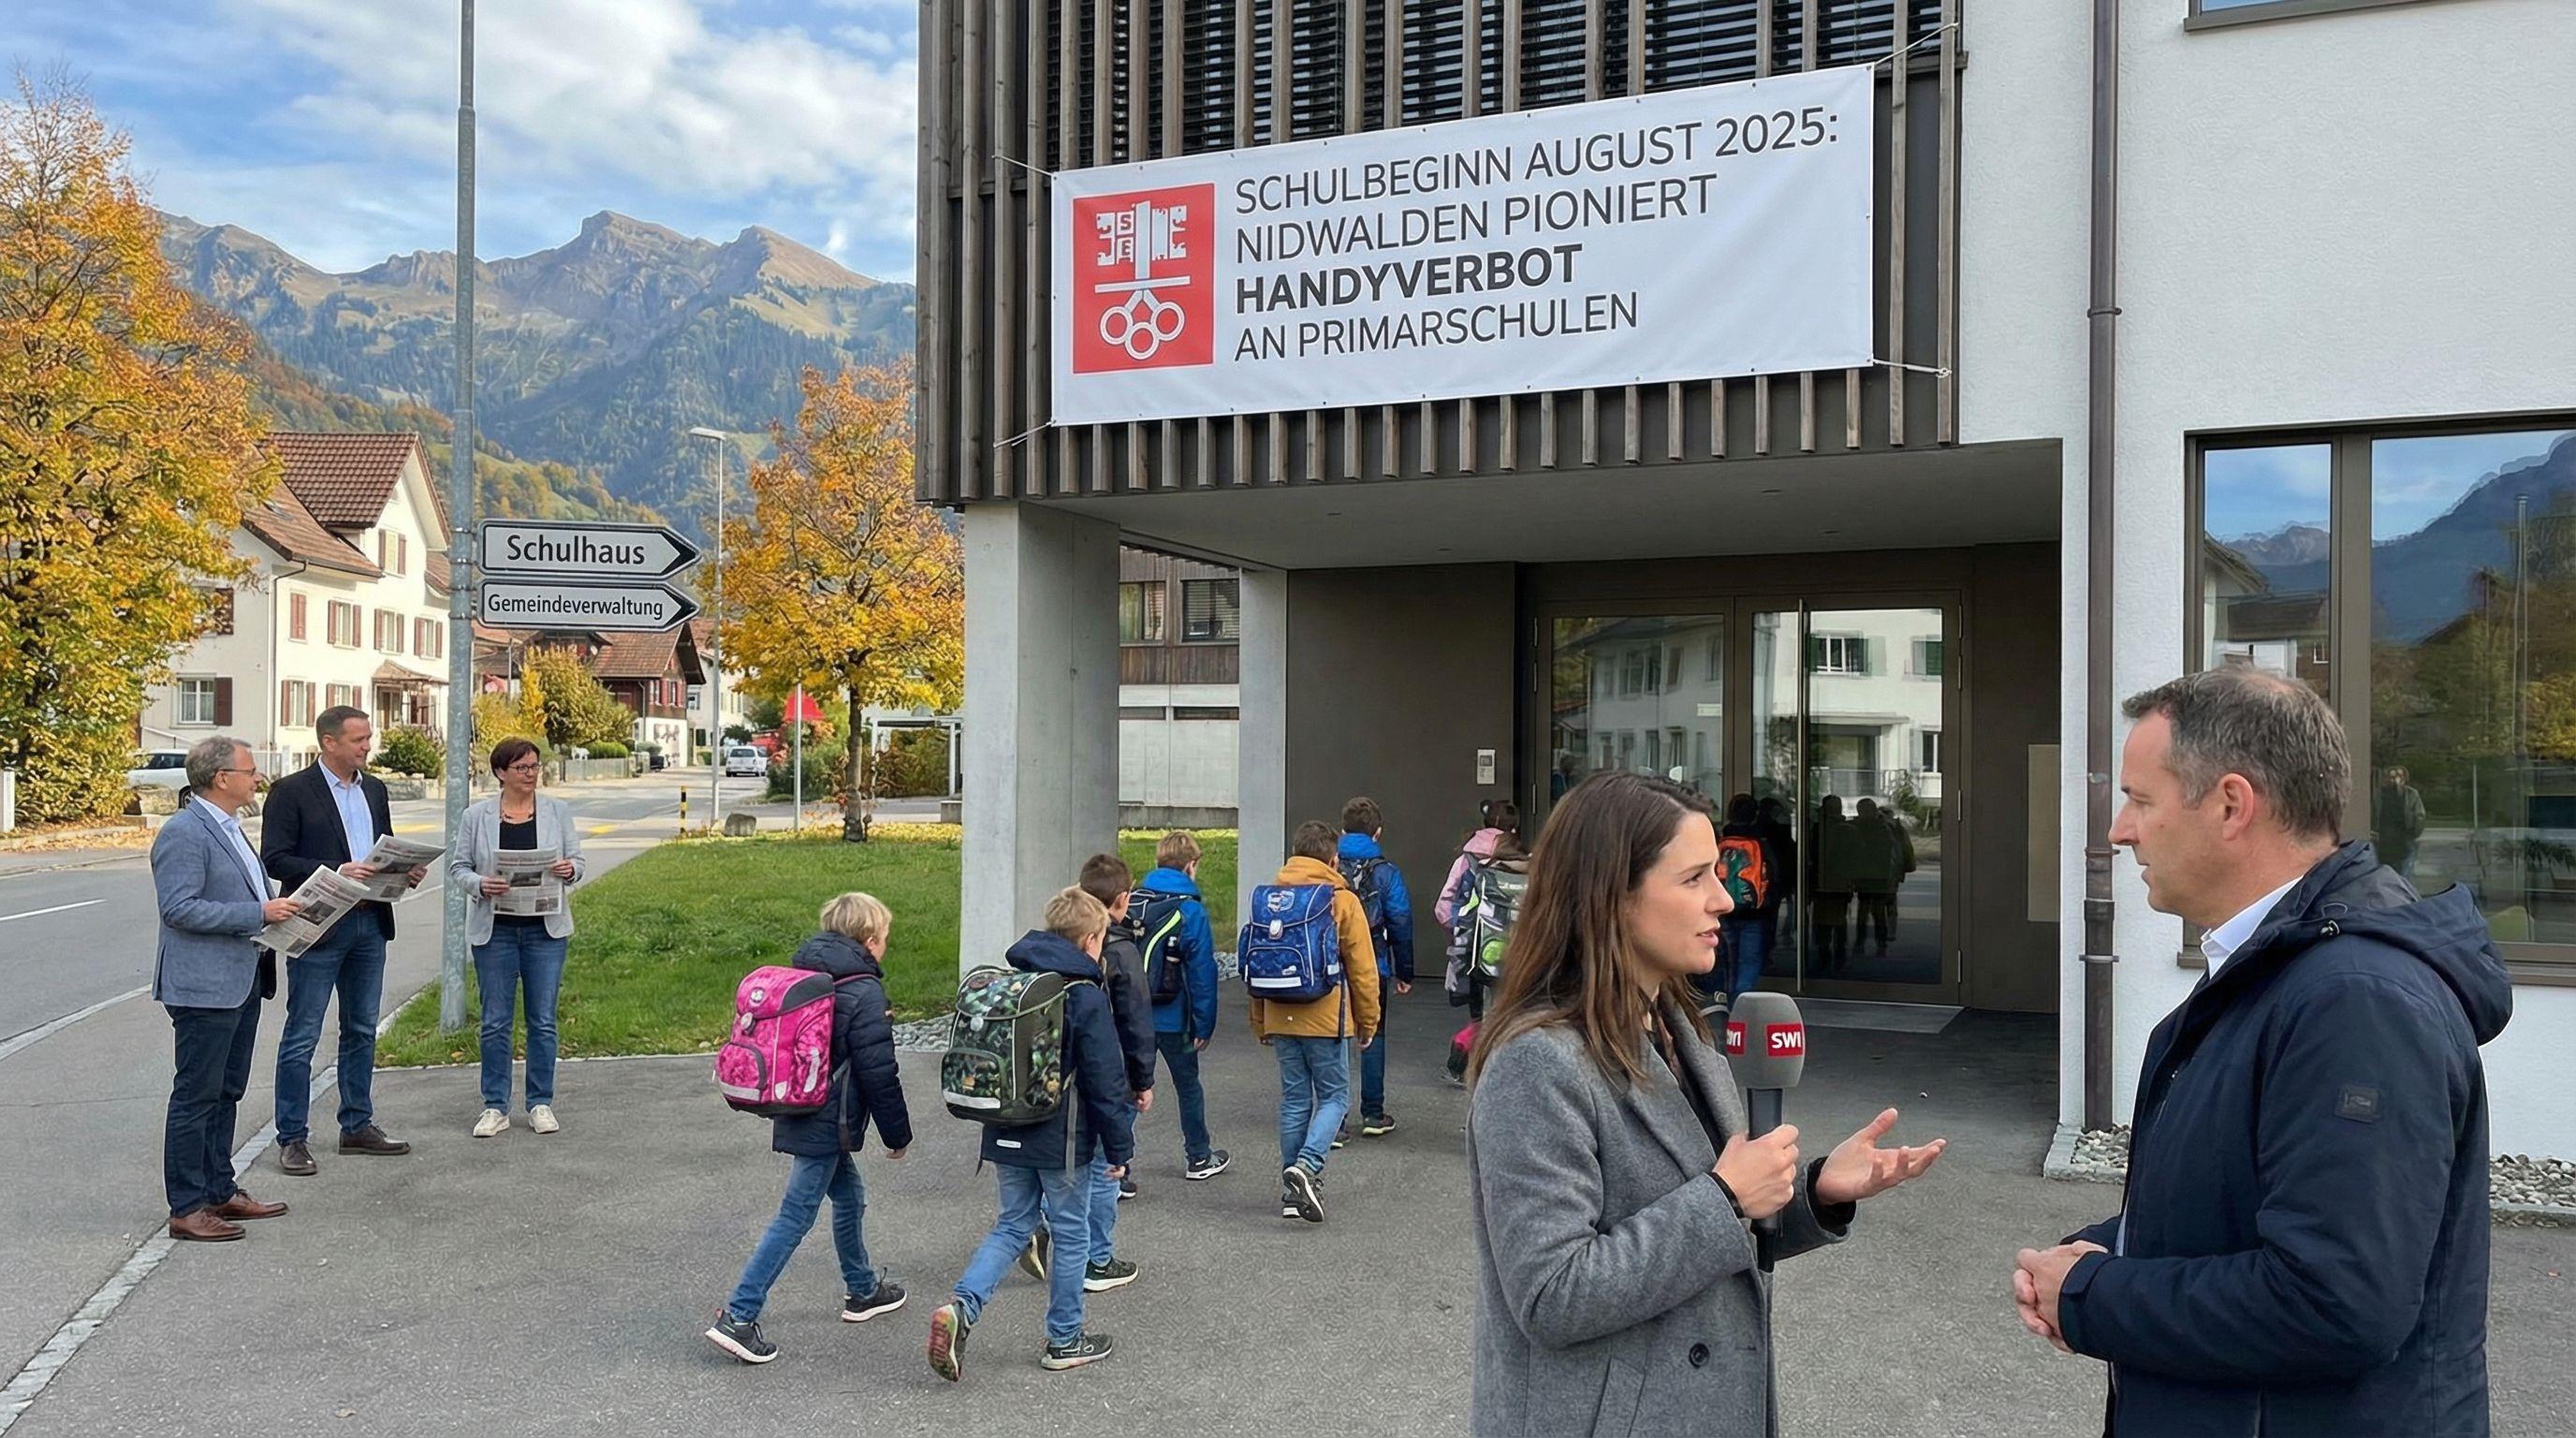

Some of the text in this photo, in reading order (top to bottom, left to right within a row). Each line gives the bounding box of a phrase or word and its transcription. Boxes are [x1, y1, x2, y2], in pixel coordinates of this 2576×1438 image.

[1236, 106, 1837, 214] SCHULBEGINN AUGUST 2025:
[1237, 173, 1718, 264] NIDWALDEN PIONIERT
[1237, 242, 1583, 315] HANDYVERBOT
[1234, 291, 1637, 362] AN PRIMARSCHULEN
[506, 534, 645, 565] Schulhaus
[488, 594, 663, 621] Gemeindeverwaltung
